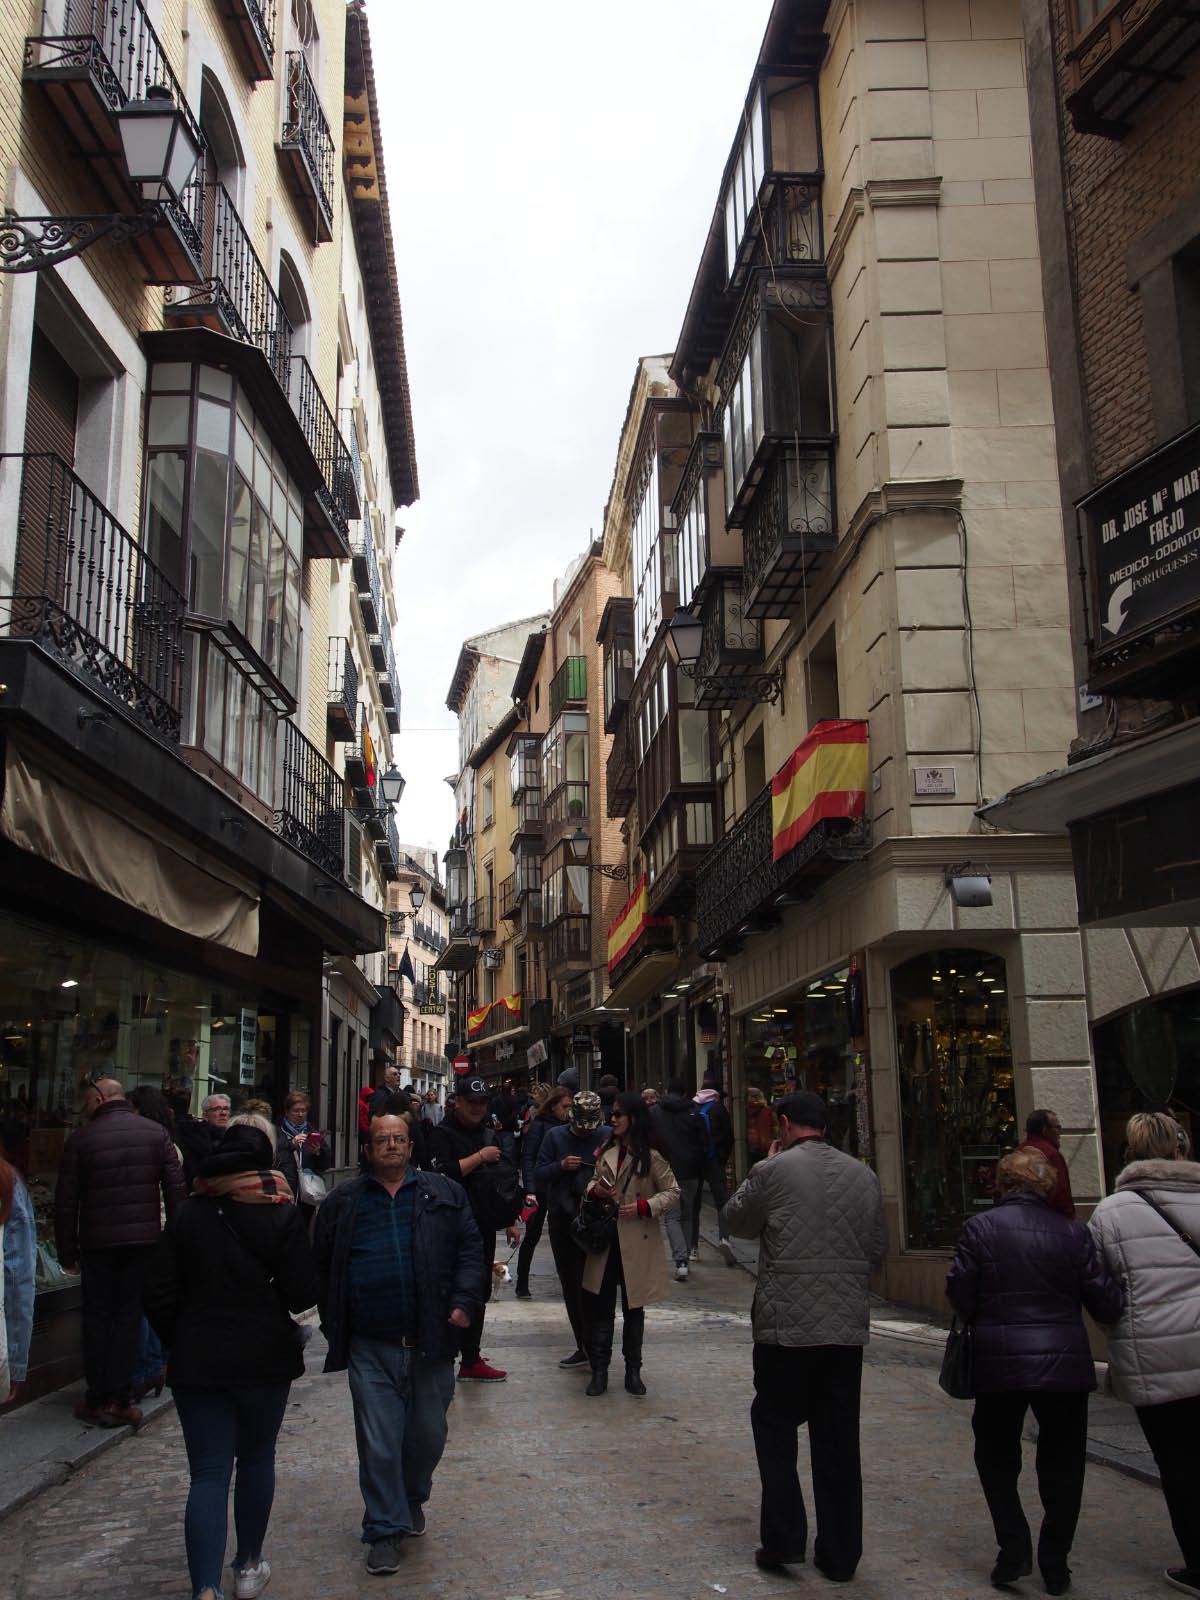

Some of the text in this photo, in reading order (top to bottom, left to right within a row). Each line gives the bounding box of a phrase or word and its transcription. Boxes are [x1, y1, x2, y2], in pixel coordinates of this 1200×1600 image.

[1102, 519, 1120, 544] DR.
[1123, 500, 1149, 532] JOSE
[1173, 467, 1200, 502] MAR
[1149, 508, 1185, 545] FREJO
[428, 966, 436, 1006] HOSTAL
[420, 1006, 444, 1014] CENTRO
[470, 1080, 486, 1092] CK
